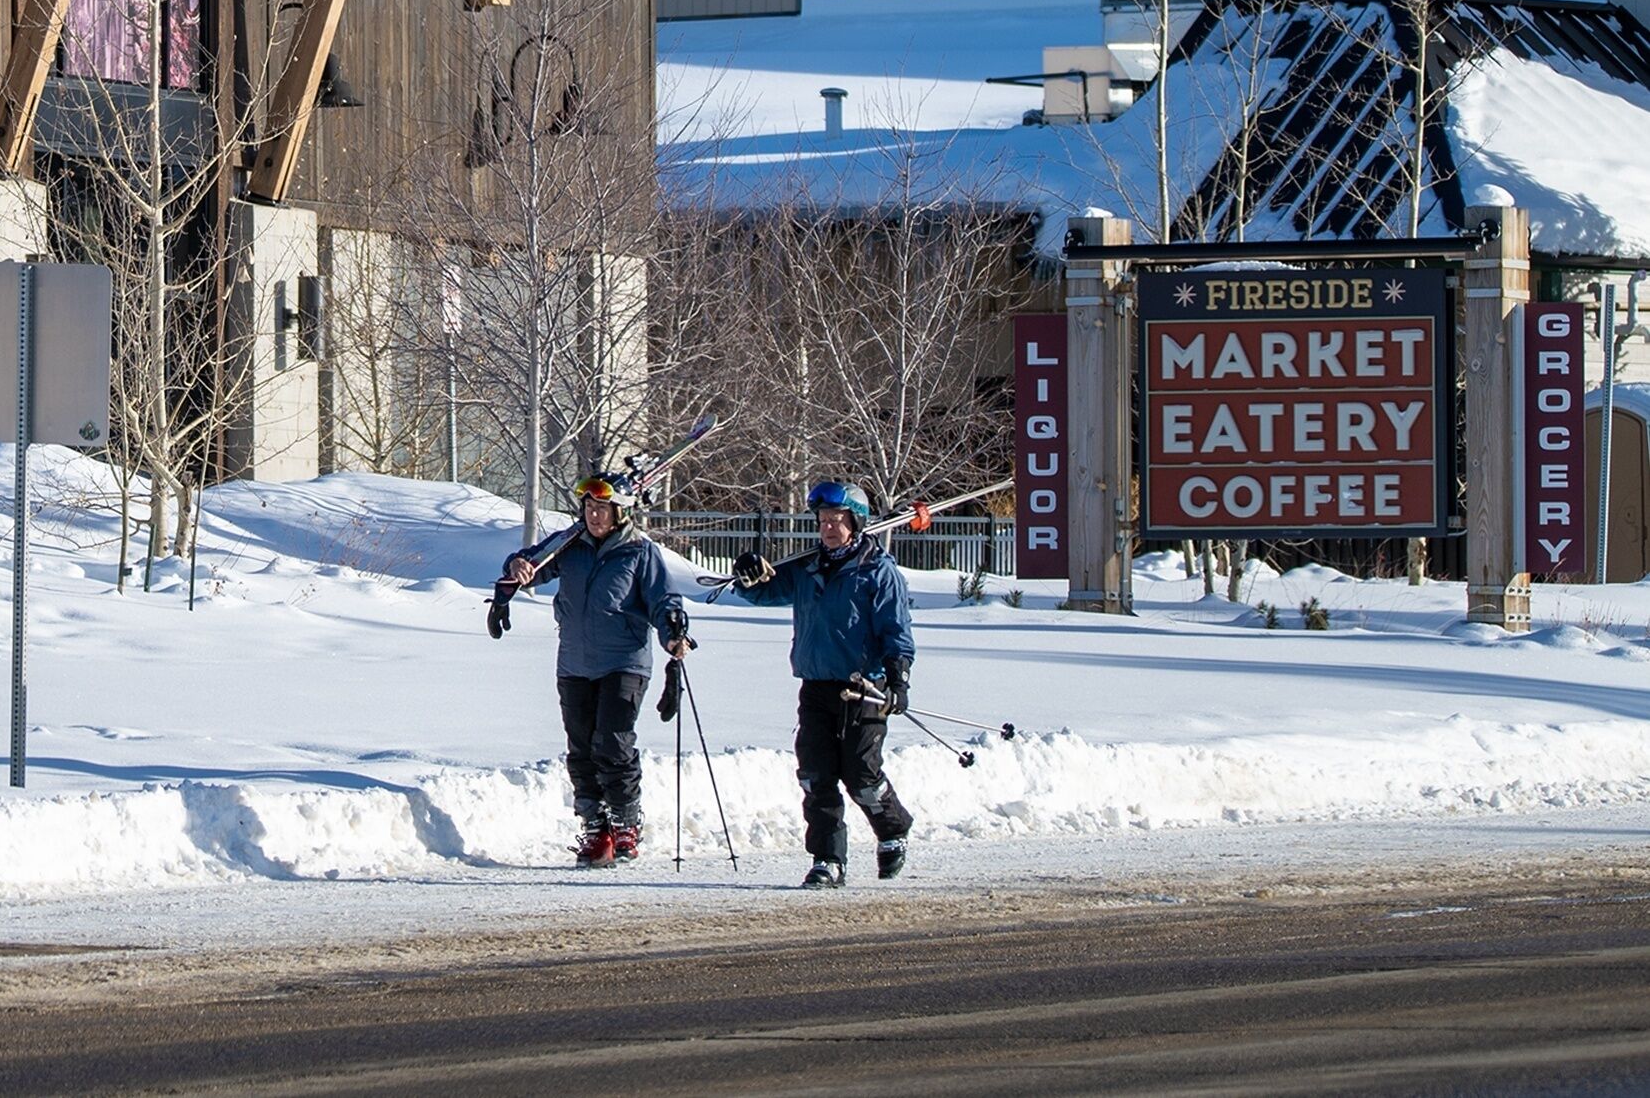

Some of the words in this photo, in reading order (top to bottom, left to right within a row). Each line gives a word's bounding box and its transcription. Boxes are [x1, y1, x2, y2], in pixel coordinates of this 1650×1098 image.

[1205, 278, 1374, 310] FIRESIDE
[1160, 328, 1426, 380] MARKET
[1025, 341, 1059, 550] LIQUOR
[1162, 401, 1426, 454] EATERY
[1537, 312, 1573, 563] GROCERY
[1178, 472, 1402, 518] COFFEE
